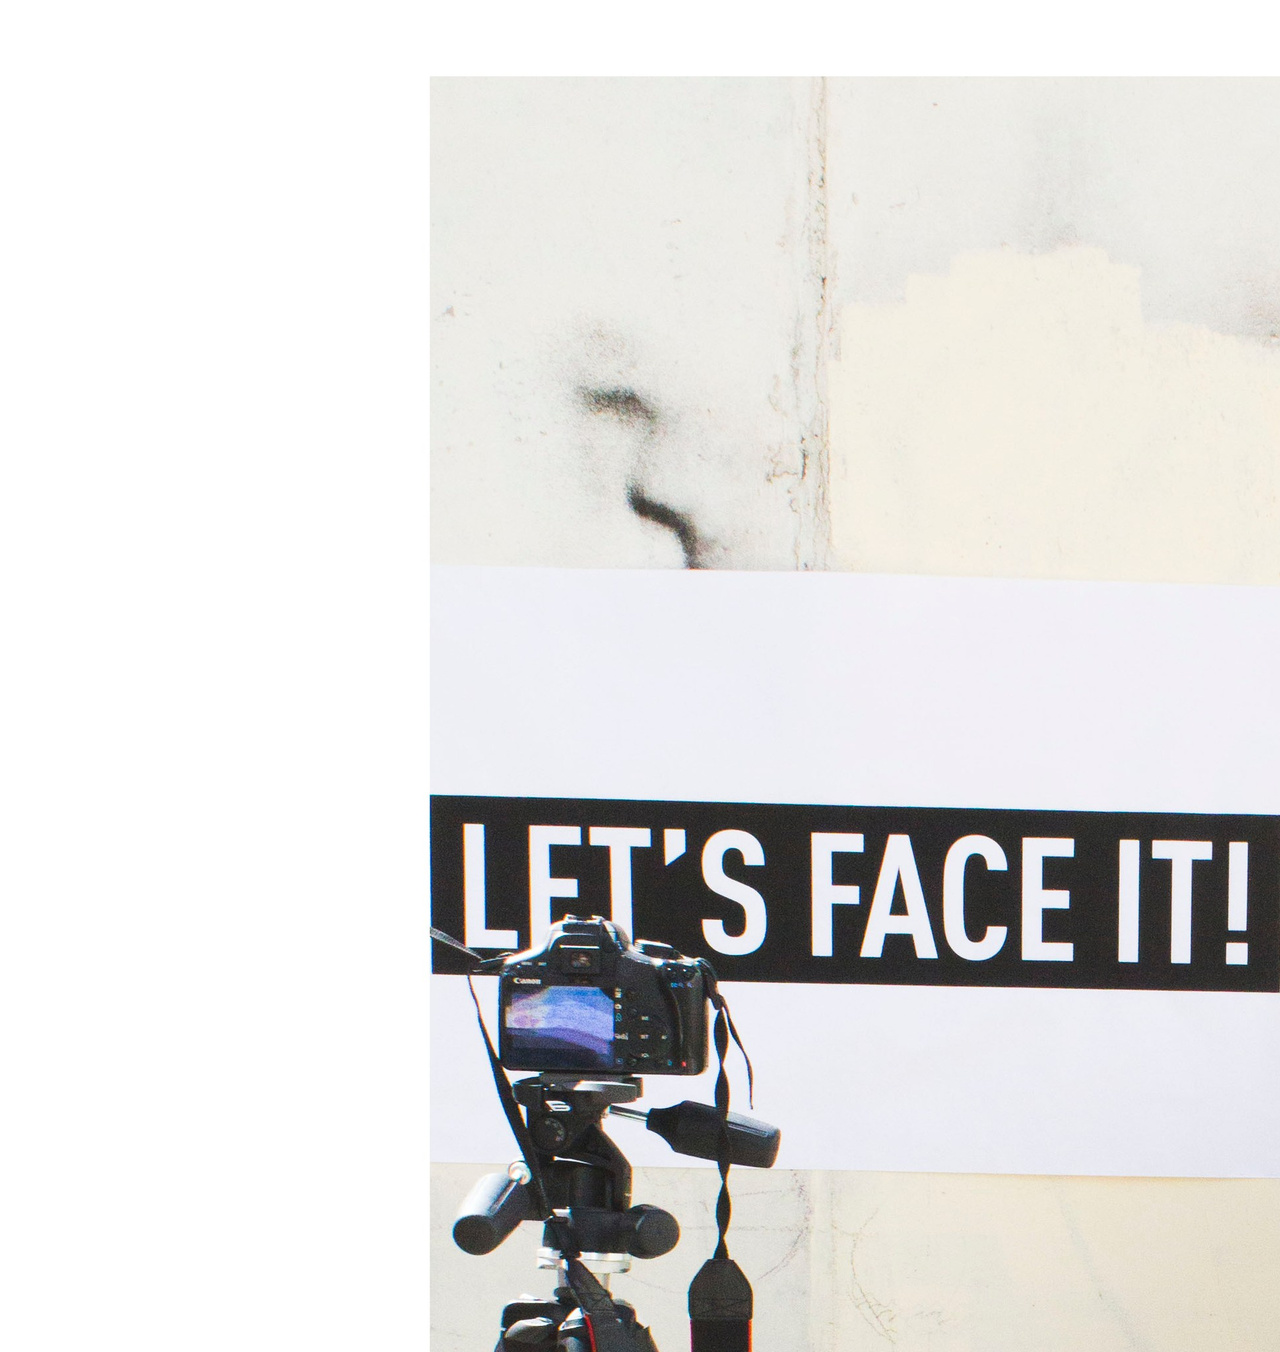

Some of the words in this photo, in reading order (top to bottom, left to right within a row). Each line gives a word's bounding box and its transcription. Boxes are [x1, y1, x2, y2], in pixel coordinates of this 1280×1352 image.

[463, 823, 767, 957] LET'S
[811, 832, 1075, 963] FACE
[1118, 839, 1249, 966] IT!
[513, 977, 542, 985] Canon
